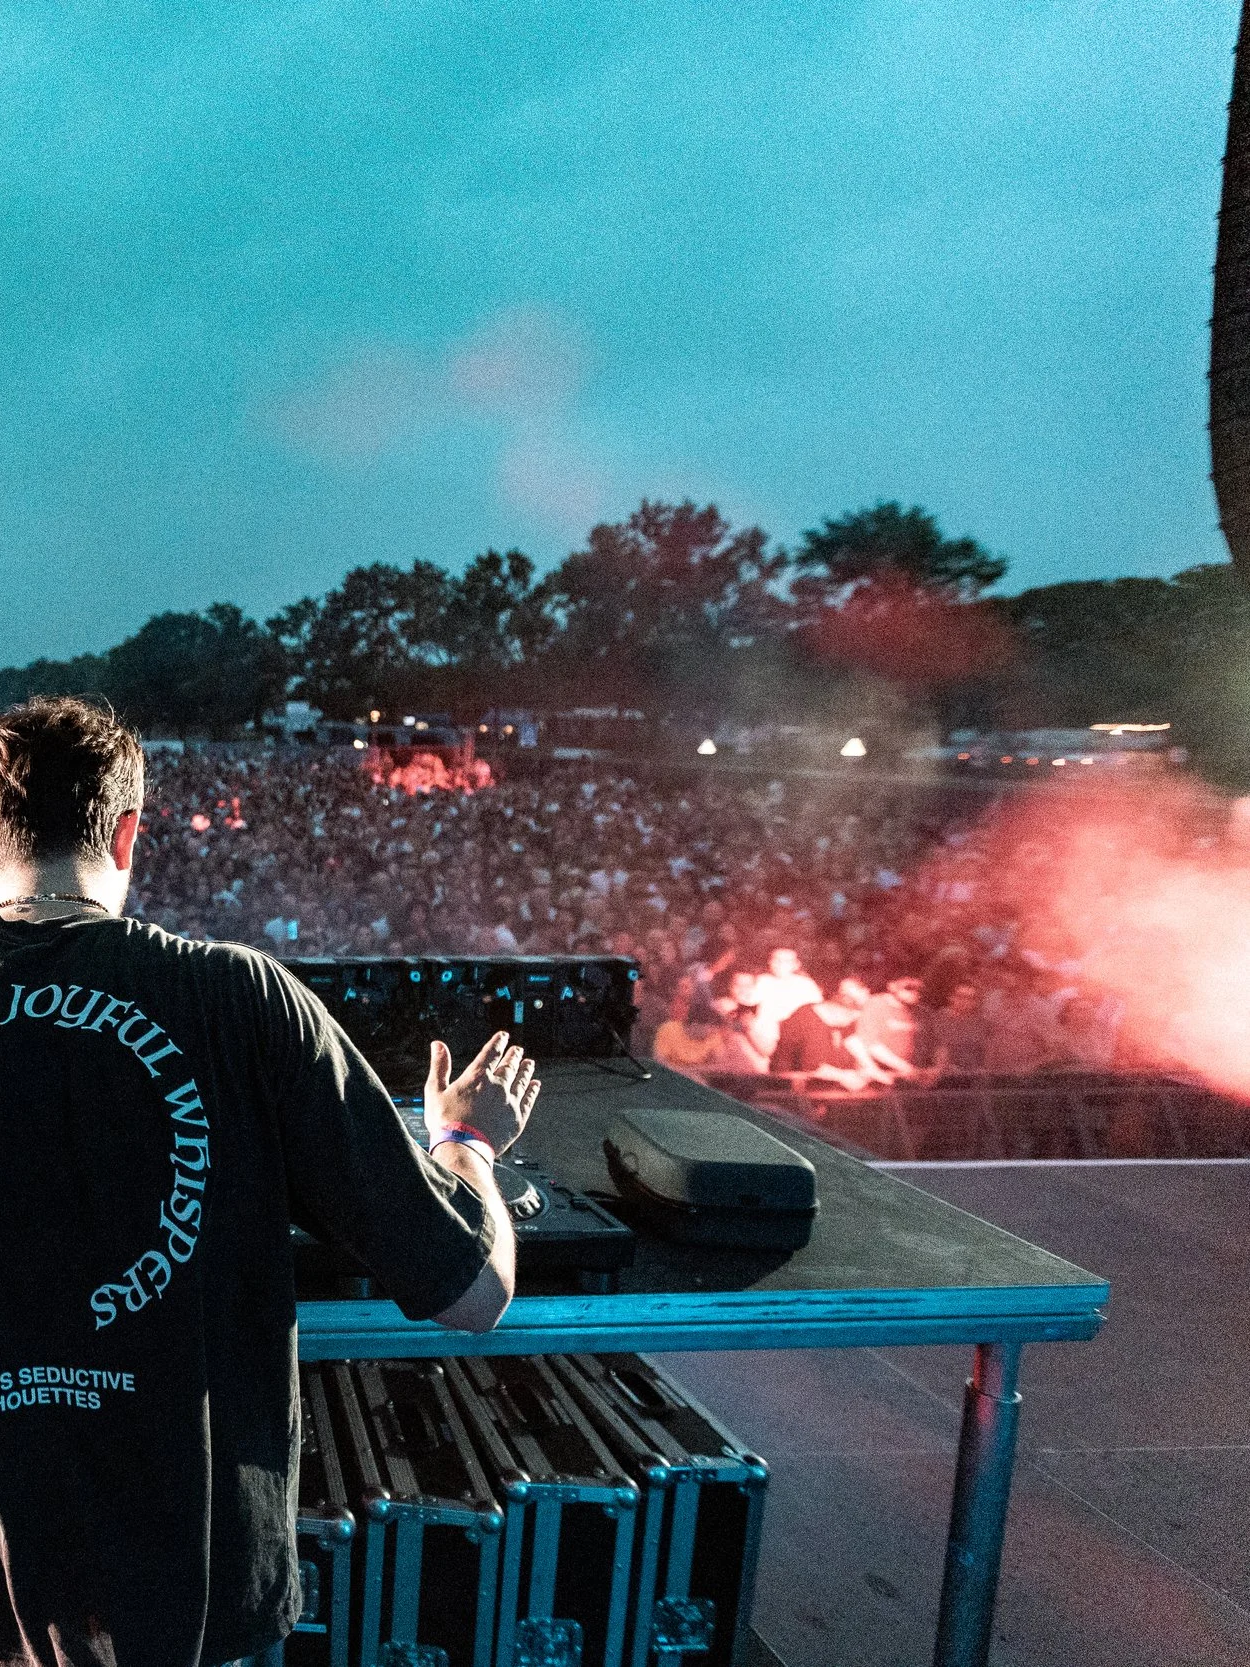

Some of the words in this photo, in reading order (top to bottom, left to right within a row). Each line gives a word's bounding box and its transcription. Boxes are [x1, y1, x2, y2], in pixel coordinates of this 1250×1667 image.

[0, 984, 183, 1078] JOYFUL
[90, 1078, 211, 1331] WHISPERS
[19, 1366, 136, 1392] SEDUCTIVE
